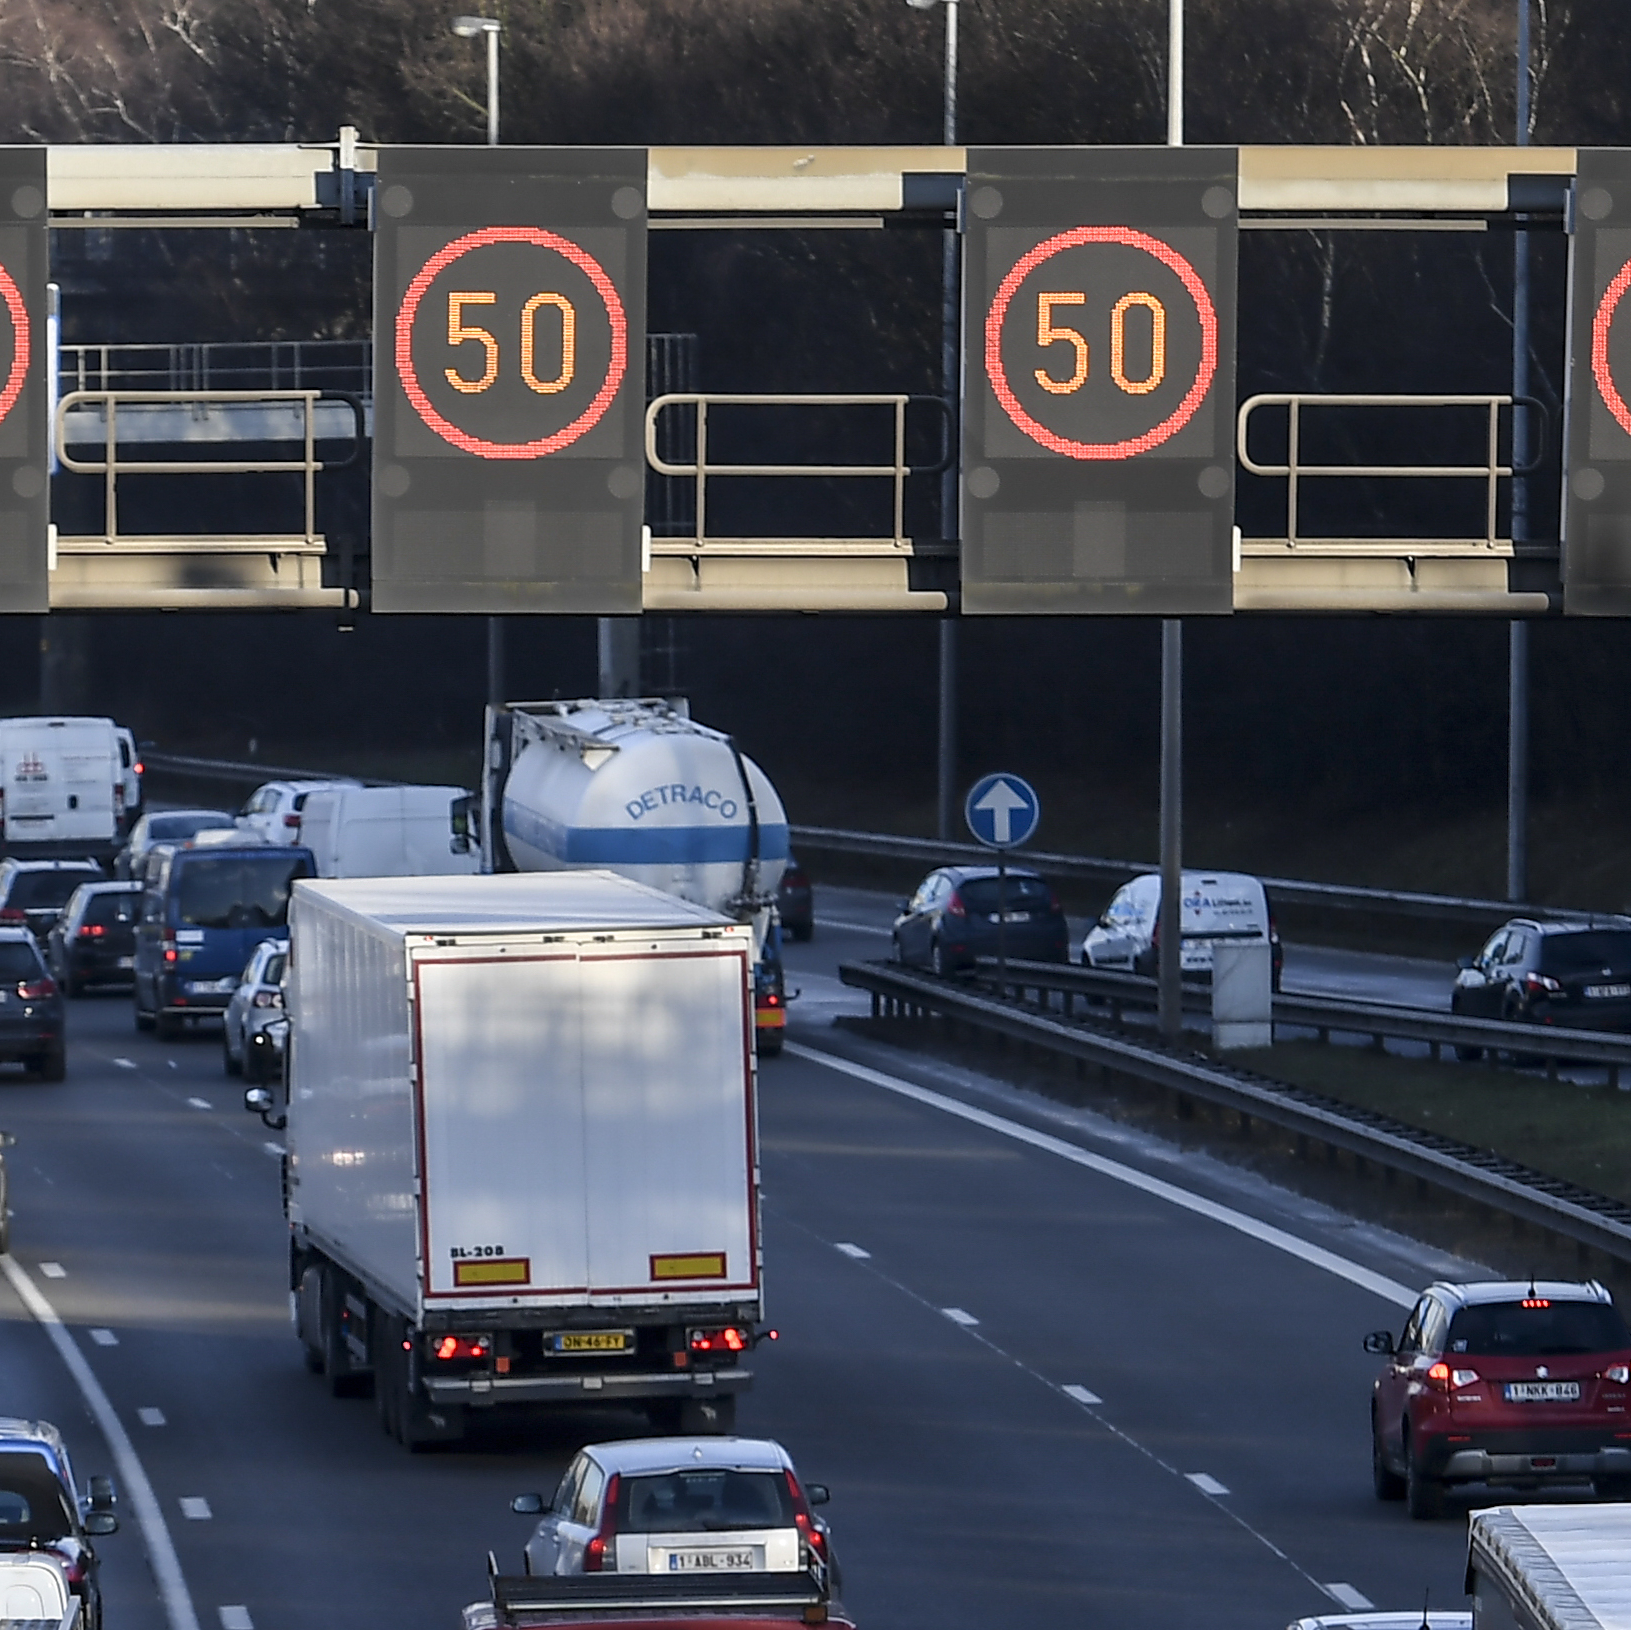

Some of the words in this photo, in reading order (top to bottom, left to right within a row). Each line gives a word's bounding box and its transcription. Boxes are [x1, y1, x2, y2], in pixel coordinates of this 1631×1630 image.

[445, 291, 576, 394] 50
[1034, 291, 1166, 394] 50
[626, 784, 737, 820] DETRACO
